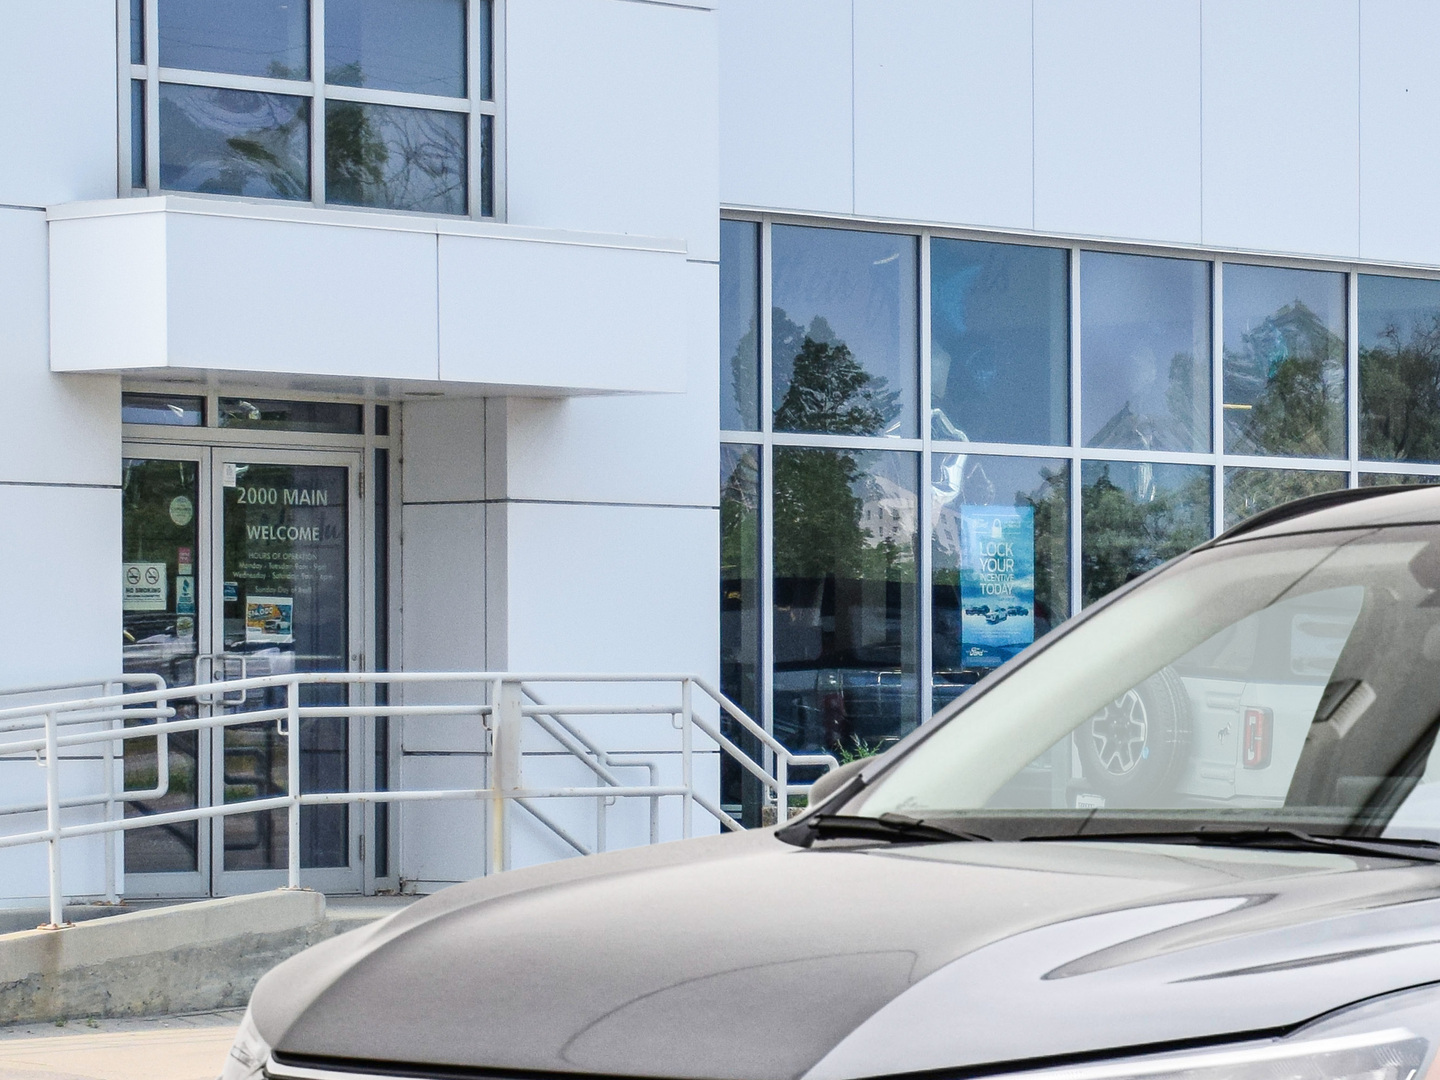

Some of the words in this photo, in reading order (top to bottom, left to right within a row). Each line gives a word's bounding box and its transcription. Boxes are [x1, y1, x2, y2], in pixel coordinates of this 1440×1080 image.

[237, 487, 277, 505] 2000
[283, 488, 328, 506] MAIN
[246, 525, 320, 541] WELCOME
[980, 542, 1014, 557] LOCK
[282, 552, 318, 560] OPERATION
[239, 562, 263, 570] Monday
[980, 558, 1014, 572] YOUR
[232, 571, 267, 580] Wednesday
[980, 573, 1015, 582] INCENTIVE
[980, 583, 1014, 595] TODAY
